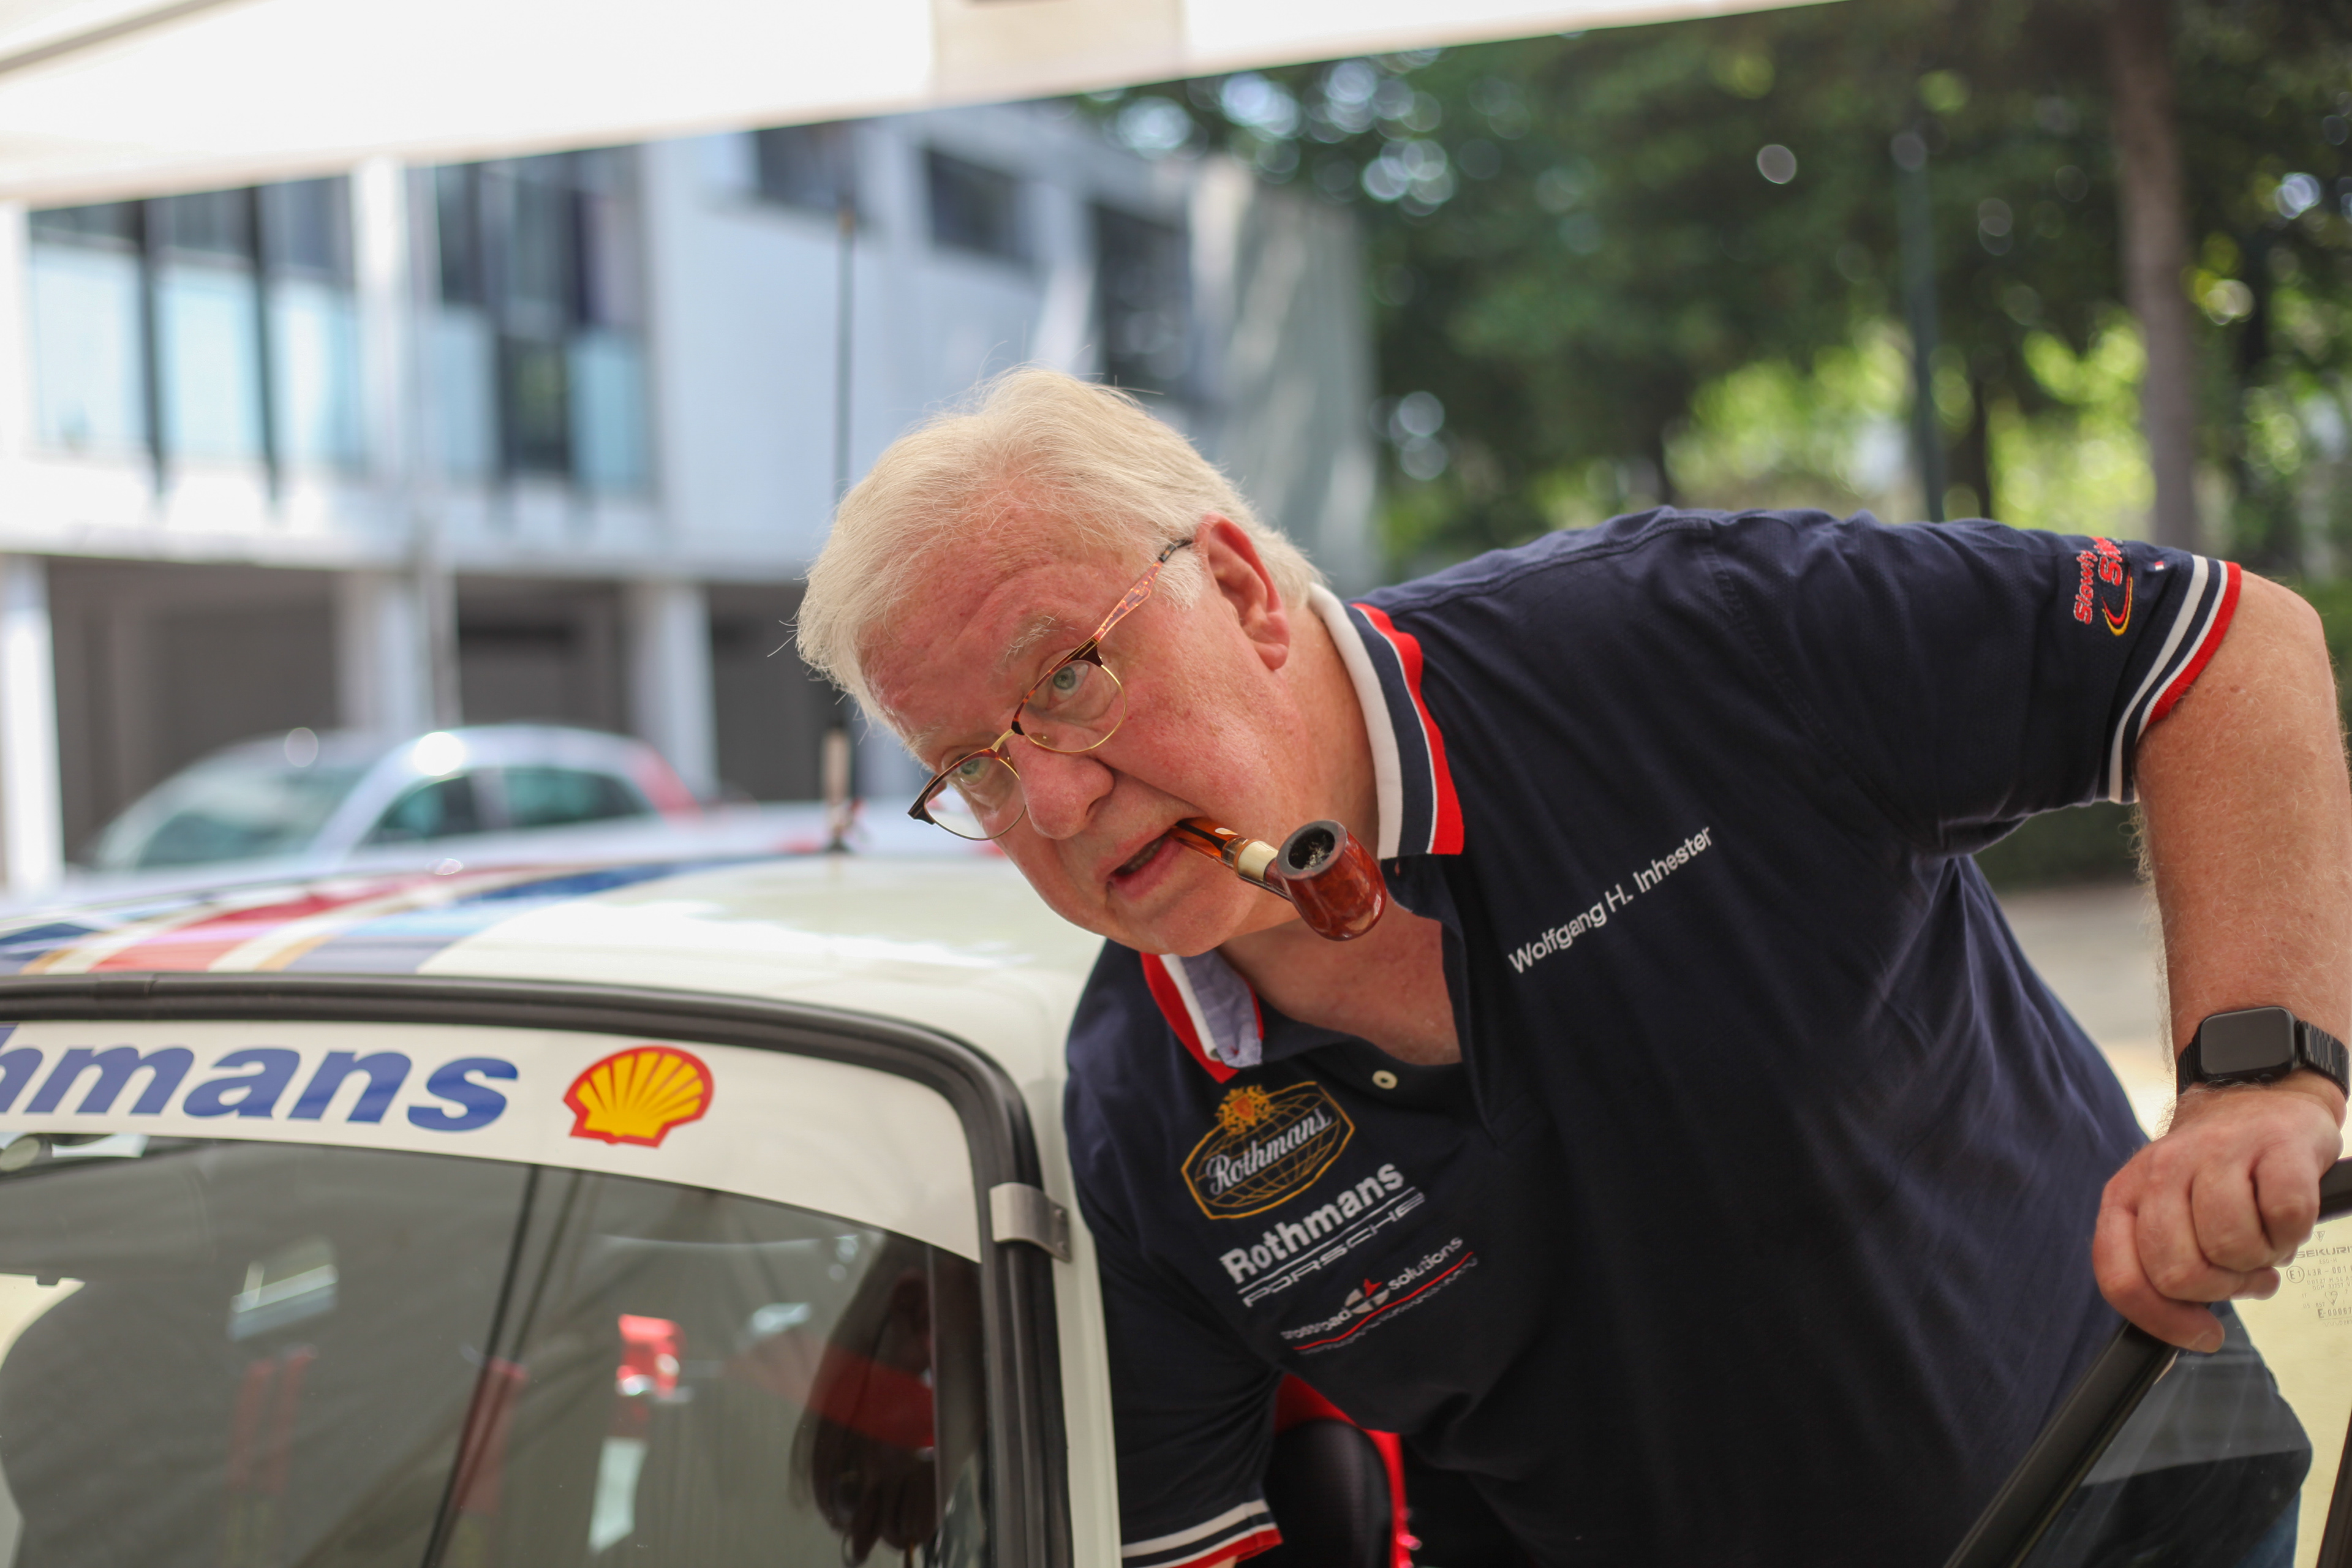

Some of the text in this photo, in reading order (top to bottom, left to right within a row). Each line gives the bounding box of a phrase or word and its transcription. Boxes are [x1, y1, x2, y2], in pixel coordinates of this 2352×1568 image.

[2073, 550, 2098, 625] Slowly
[1508, 826, 1713, 973] Wolfgang H. Inhester
[1205, 1107, 1332, 1195] Rothmans
[1219, 1163, 1404, 1284] Rothmans
[1242, 1193, 1425, 1308] PORSCHE
[1387, 1237, 1463, 1291] solutions
[2296, 1246, 2352, 1259] SEKURI
